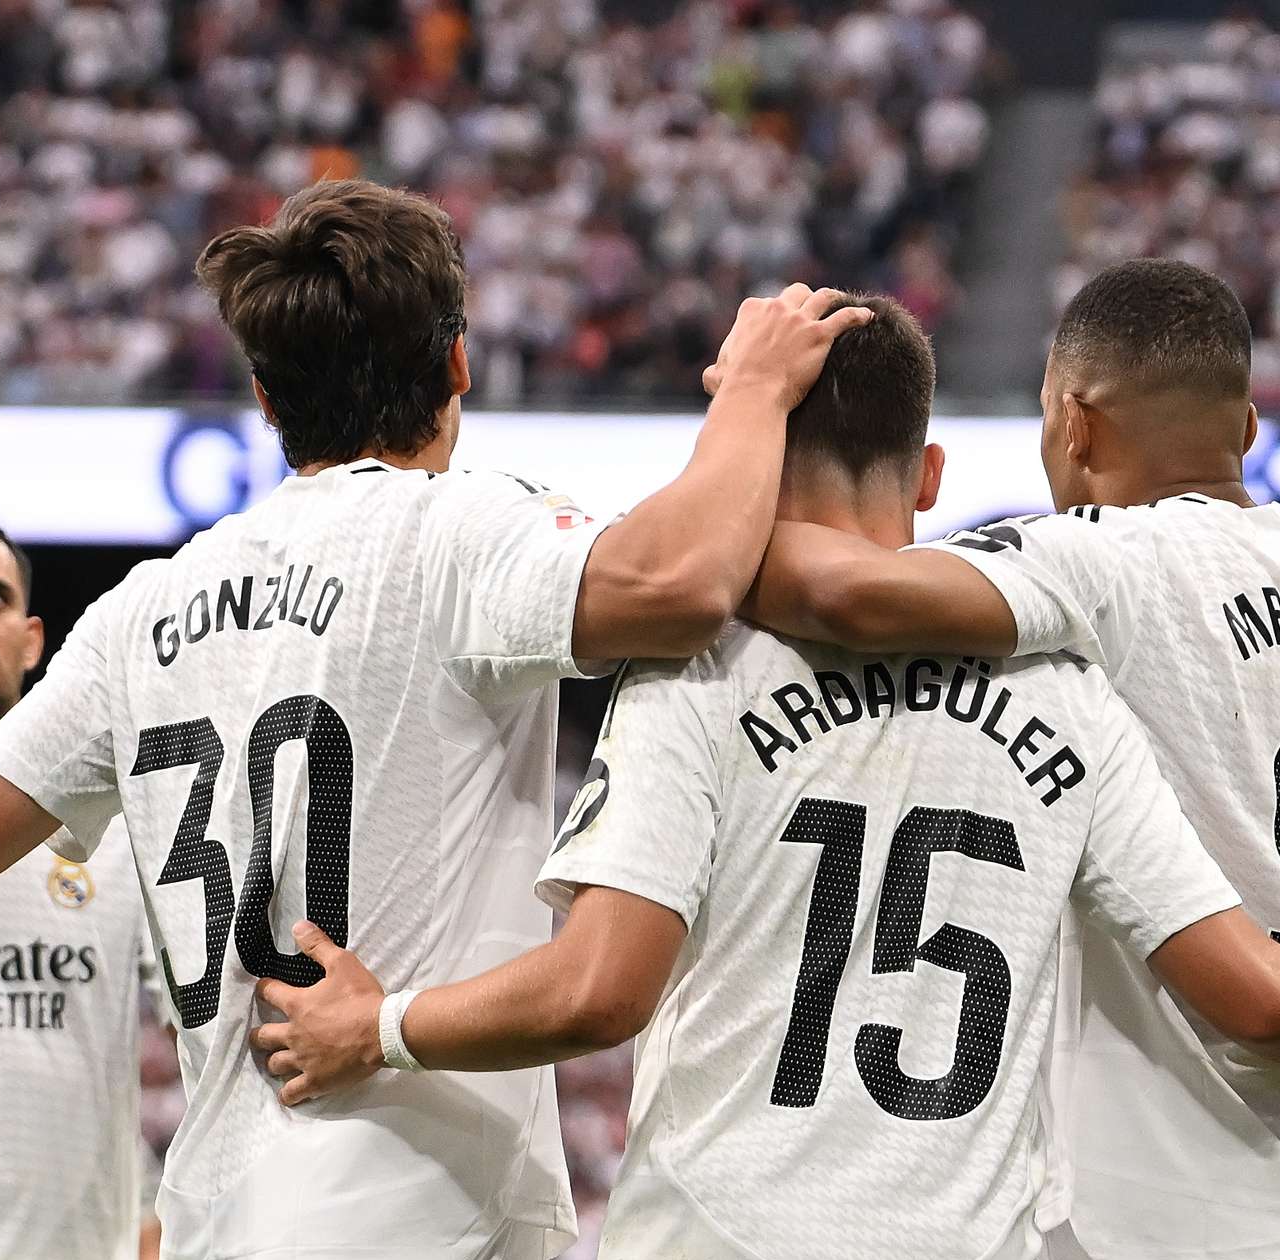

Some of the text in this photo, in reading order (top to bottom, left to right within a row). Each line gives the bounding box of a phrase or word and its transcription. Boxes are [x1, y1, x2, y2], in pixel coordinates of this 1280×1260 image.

[129, 694, 354, 1029] 30
[738, 656, 1086, 808] ARDAGÜLER
[770, 797, 1026, 1121] 15
